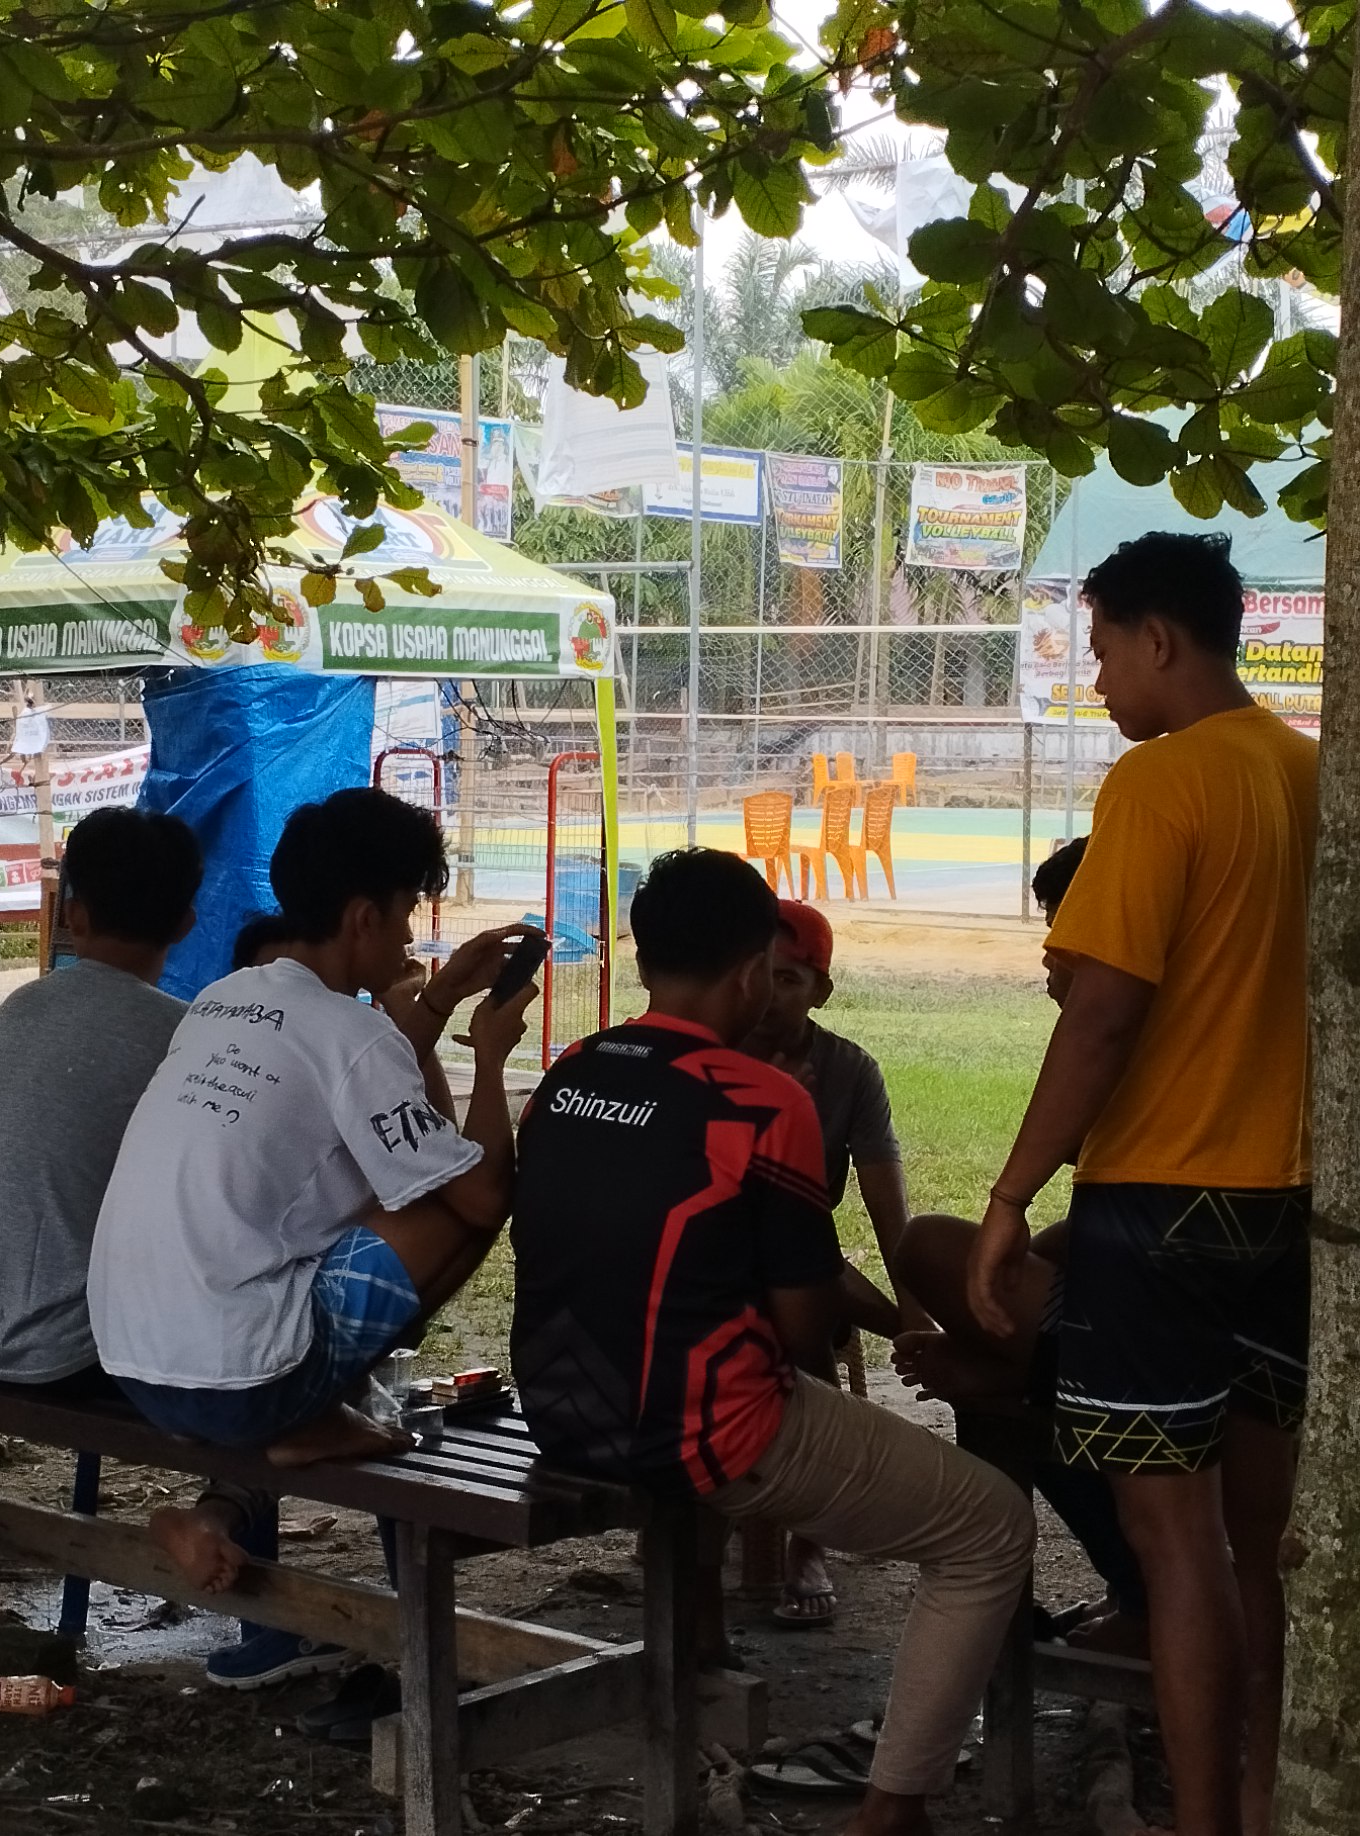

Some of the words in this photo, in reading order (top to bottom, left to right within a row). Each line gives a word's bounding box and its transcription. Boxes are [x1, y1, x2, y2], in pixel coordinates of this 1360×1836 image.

[917, 506, 1022, 526] TOURNAMENT
[921, 524, 1016, 541] VOLLEYBALL
[7, 622, 58, 659] USAHA
[61, 618, 164, 656] MANUNGGAL
[330, 621, 388, 658] KOPSA
[392, 624, 448, 660] USAHA
[453, 626, 553, 662] MANUNGGAL
[1237, 661, 1324, 683] ertandi
[1051, 683, 1084, 702] SEI
[84, 784, 130, 804] SISTEM
[549, 1087, 659, 1127] Shinzuii
